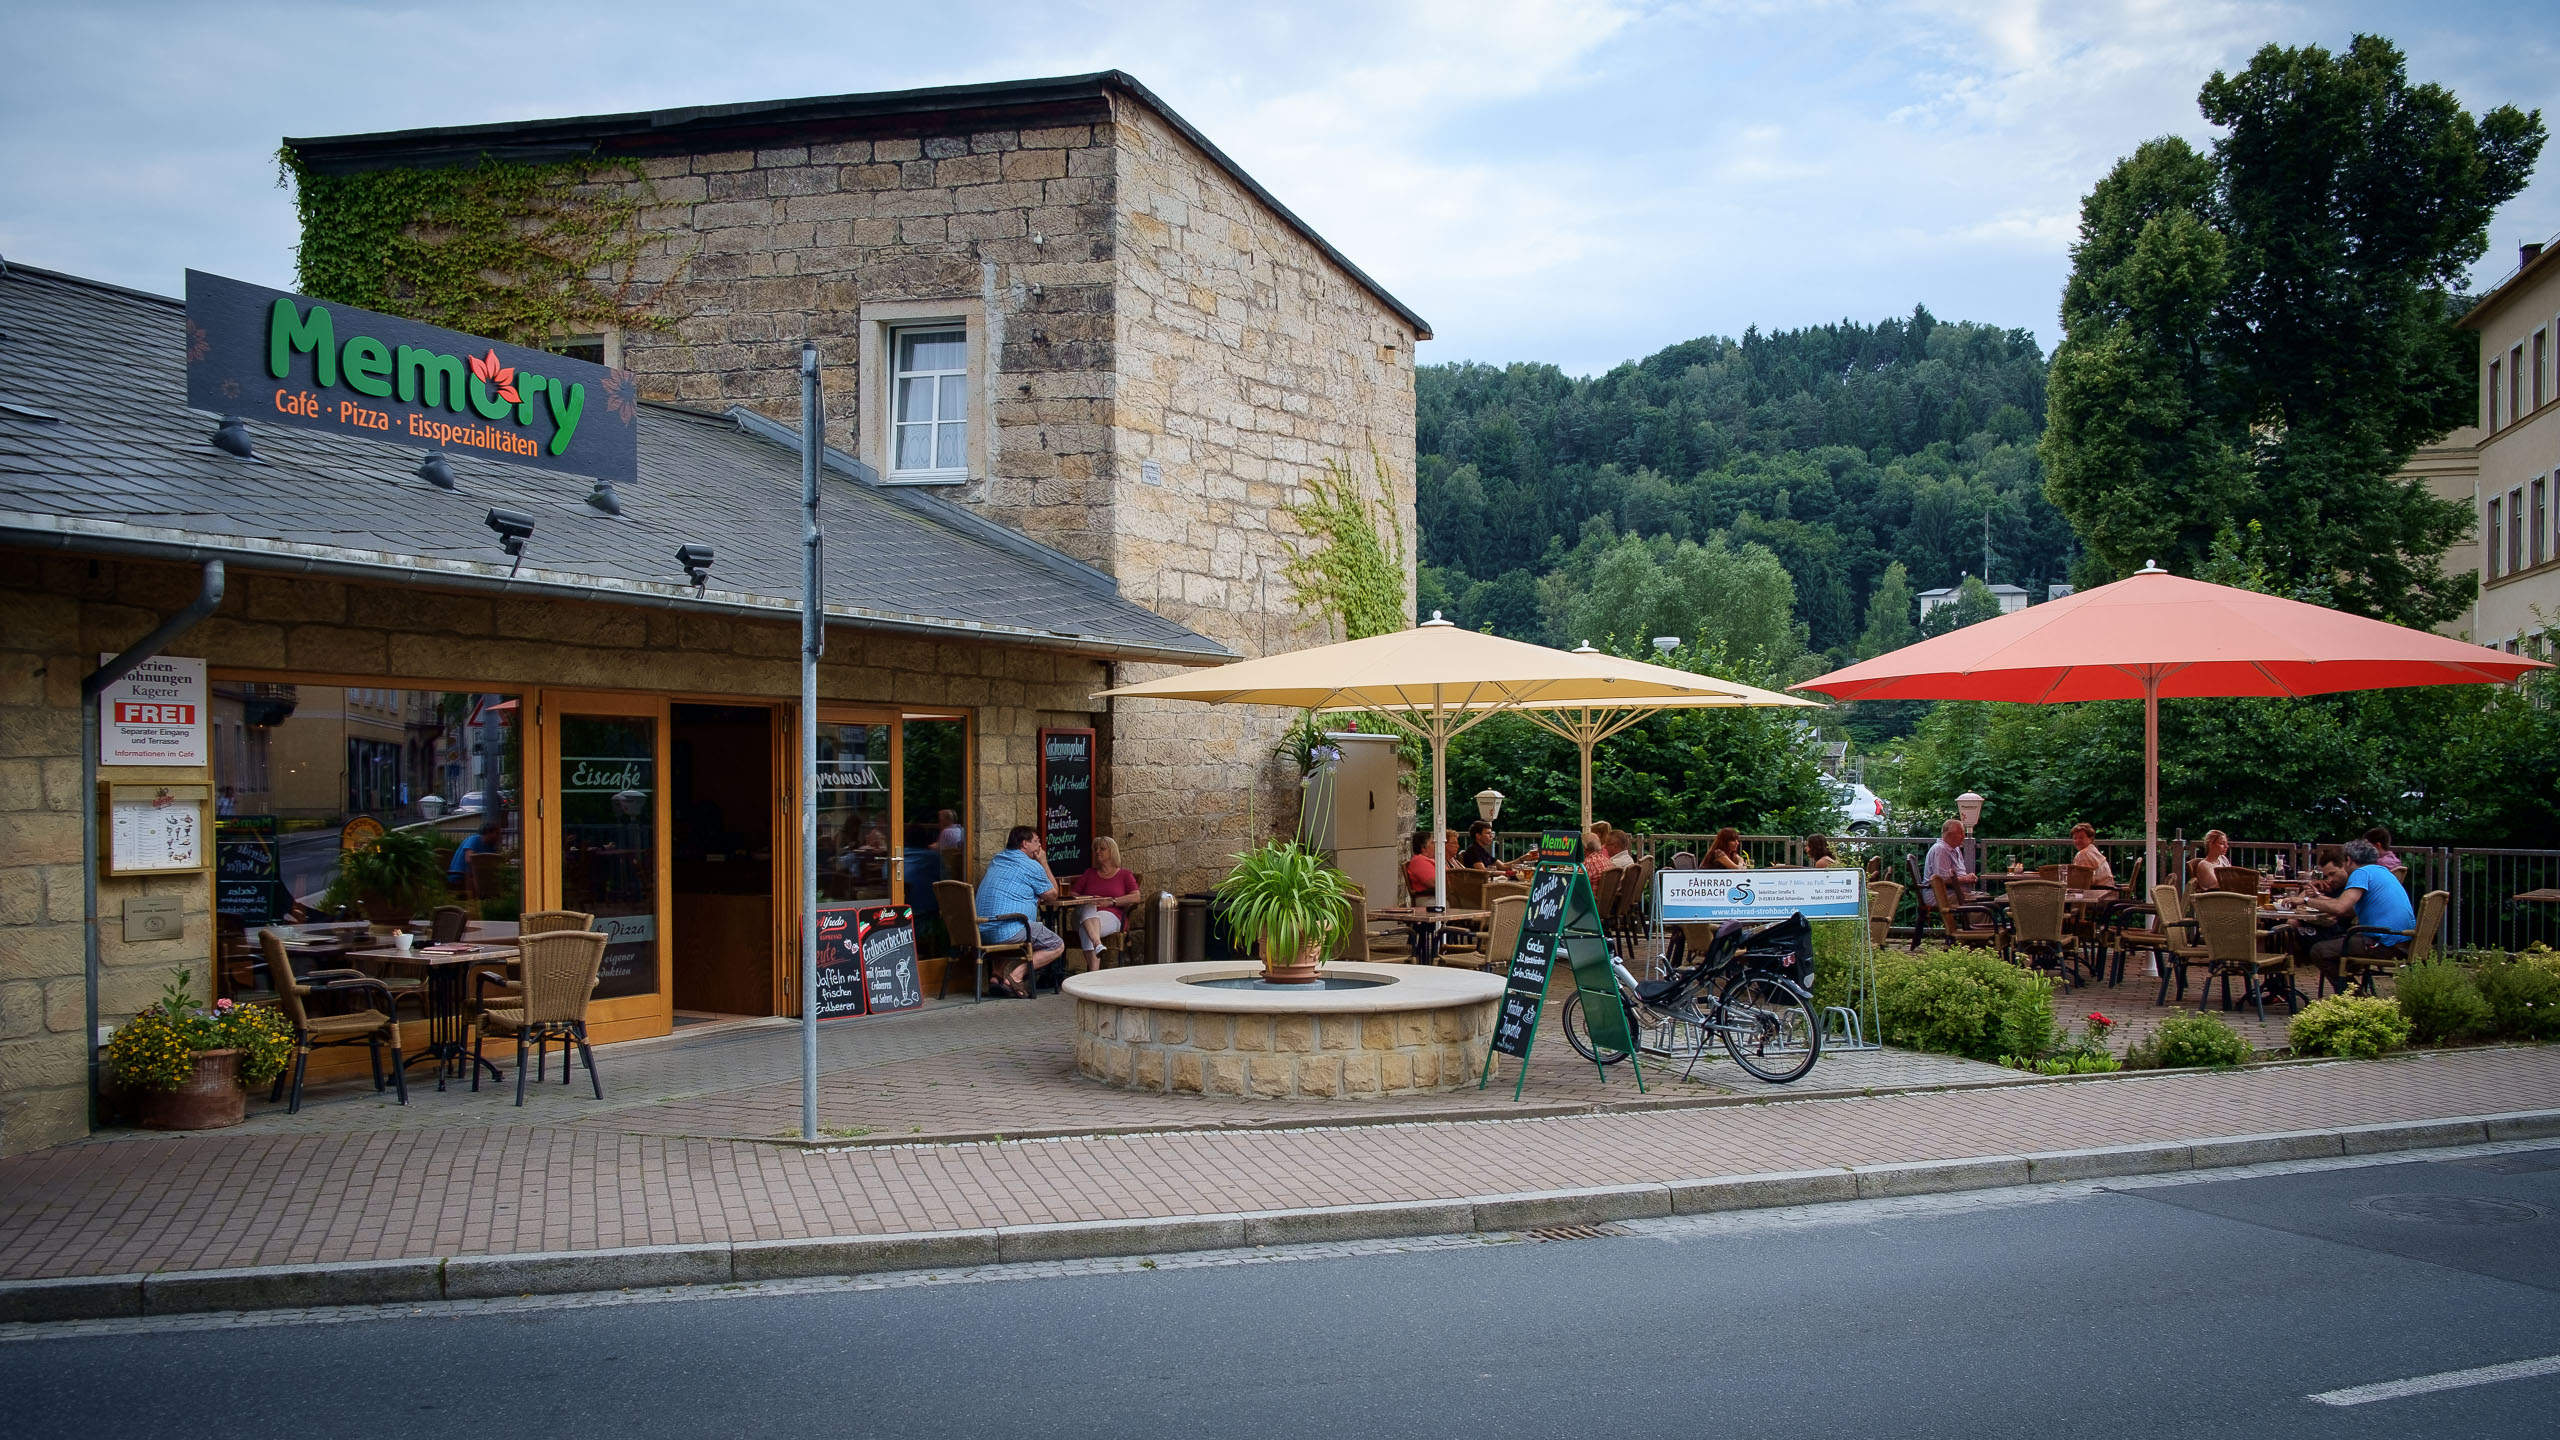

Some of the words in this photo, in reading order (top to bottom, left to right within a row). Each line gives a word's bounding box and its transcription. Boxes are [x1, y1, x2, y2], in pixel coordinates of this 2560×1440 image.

[269, 297, 586, 457] Memory
[275, 388, 319, 419] Café
[340, 400, 389, 431] Pizza
[409, 412, 539, 458] Eisspezialitäten
[133, 661, 178, 672] erien-
[132, 685, 179, 699] Kagerer
[125, 705, 186, 724] FREI
[121, 728, 157, 736] Separater
[160, 729, 190, 737] Eingang
[114, 750, 166, 758] Informationen
[572, 761, 641, 791] Eiscafé
[1047, 832, 1077, 845] Dresdner
[1541, 833, 1577, 854] Memory
[1532, 874, 1558, 903] Getreide
[1670, 888, 1725, 897] STROHBACH
[873, 908, 897, 921] Alfredo
[1539, 898, 1558, 919] Kaffee
[1711, 906, 1799, 918] www.fahrrad-strohbach.de
[608, 920, 645, 943] Pizza
[863, 927, 913, 962] Erdbeerbecher
[604, 952, 636, 966] eigener
[816, 942, 837, 965] eute
[847, 968, 860, 983] mit
[866, 966, 875, 979] mit
[875, 966, 892, 980] frischen
[822, 986, 852, 1001] frischen
[871, 995, 879, 1005] und
[879, 994, 893, 1005] Sahne
[816, 1002, 856, 1015] Erdbeeren
